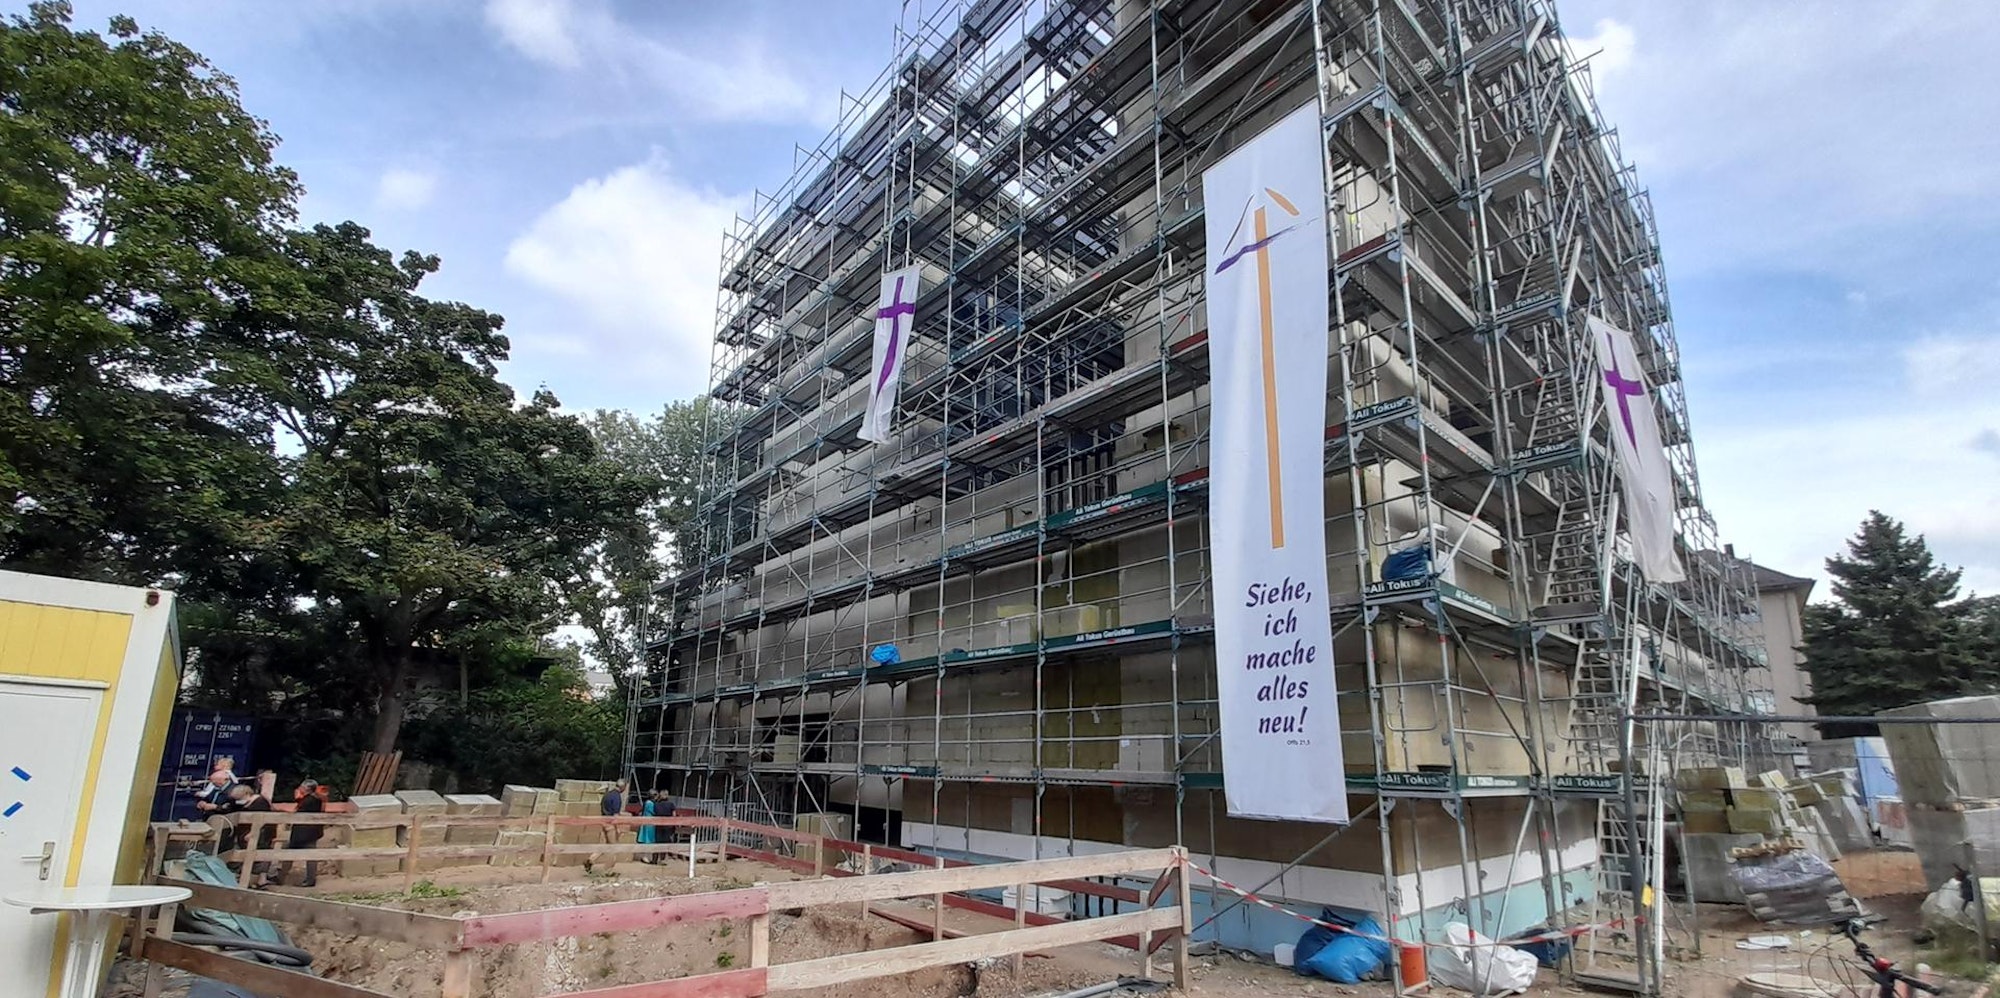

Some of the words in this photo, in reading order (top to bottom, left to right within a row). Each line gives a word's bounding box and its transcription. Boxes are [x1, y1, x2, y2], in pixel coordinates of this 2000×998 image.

[1355, 408, 1370, 420] Ali
[1371, 399, 1405, 414] Tokus
[1517, 448, 1532, 459] Ali
[1246, 576, 1311, 608] Siehe,
[1370, 582, 1385, 593] Ali
[1387, 580, 1421, 591] Tokus
[1264, 607, 1297, 636] ich
[1246, 638, 1315, 670] mache
[1257, 674, 1309, 701] alles
[1259, 706, 1308, 734] neu!
[1385, 773, 1401, 784] Ali
[1403, 774, 1438, 785] Tokus
[1557, 777, 1573, 787] Ali
[1577, 777, 1611, 788] Tokus
